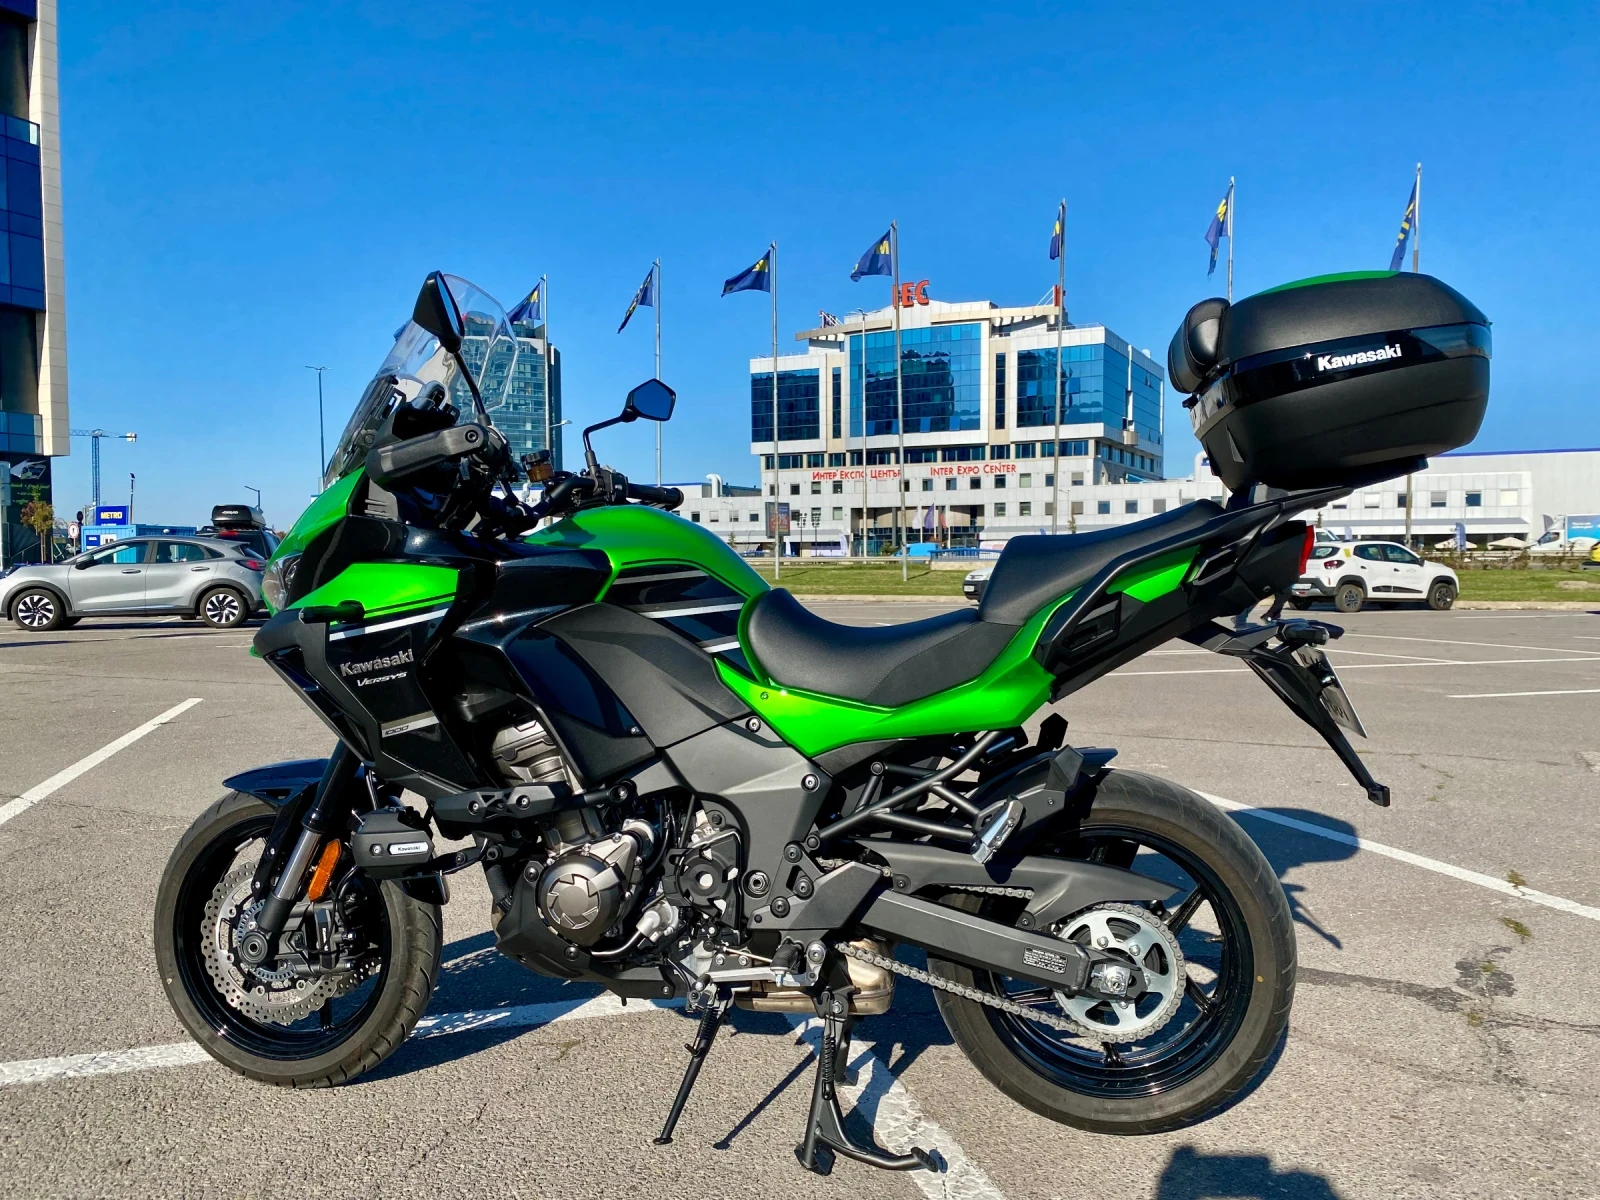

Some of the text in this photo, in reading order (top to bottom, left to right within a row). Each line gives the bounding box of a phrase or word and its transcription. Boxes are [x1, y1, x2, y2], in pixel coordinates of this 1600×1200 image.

[1317, 343, 1402, 371] Kawasaki
[930, 464, 1017, 476] INTER EXPO CENTER
[340, 648, 414, 677] Kawasaki
